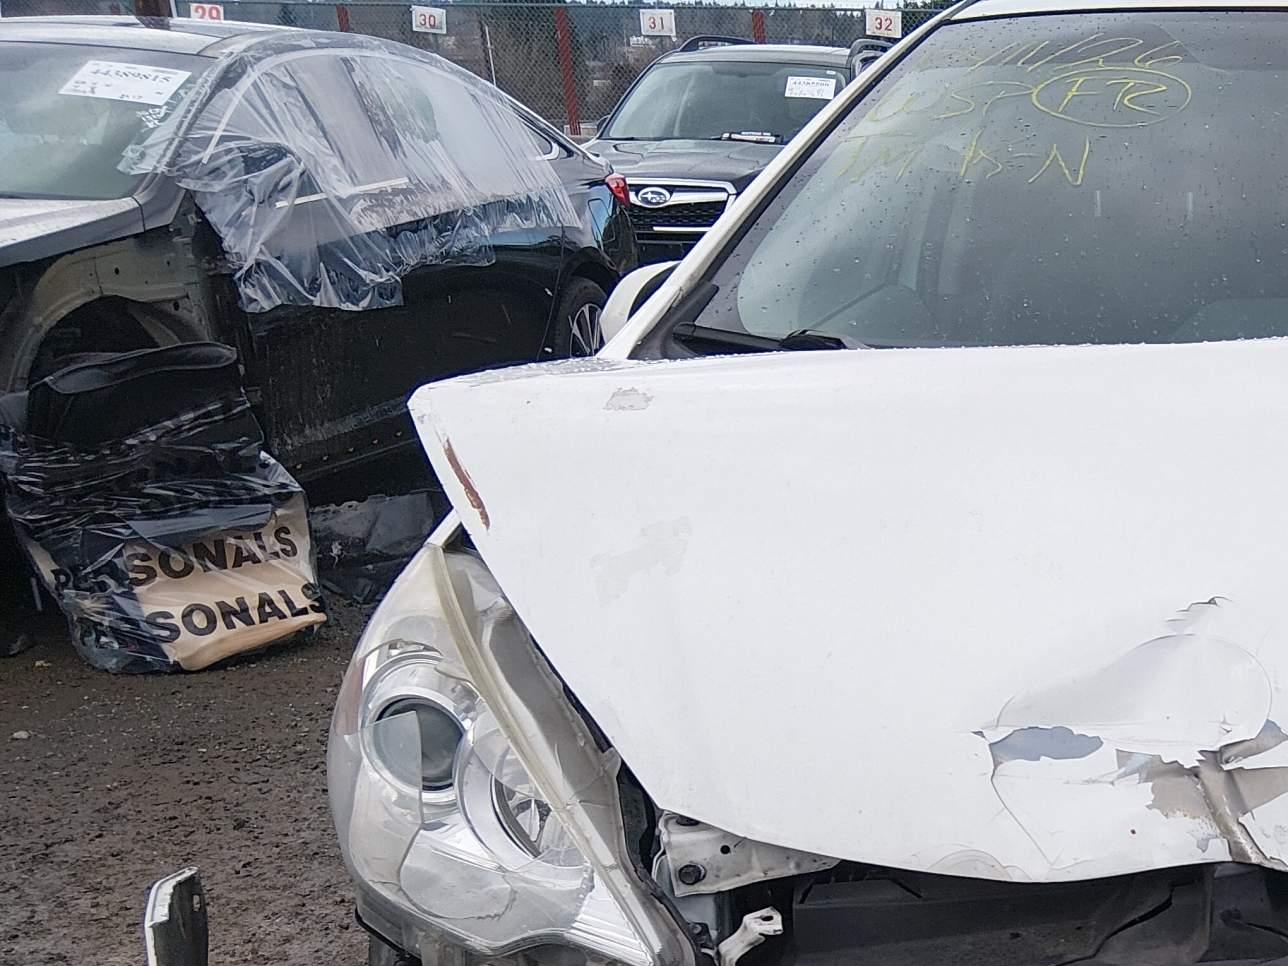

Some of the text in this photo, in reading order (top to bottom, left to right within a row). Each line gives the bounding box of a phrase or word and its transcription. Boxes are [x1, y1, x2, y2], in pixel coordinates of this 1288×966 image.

[419, 13, 437, 27] 30
[648, 16, 665, 30] 31
[874, 17, 893, 32] 32
